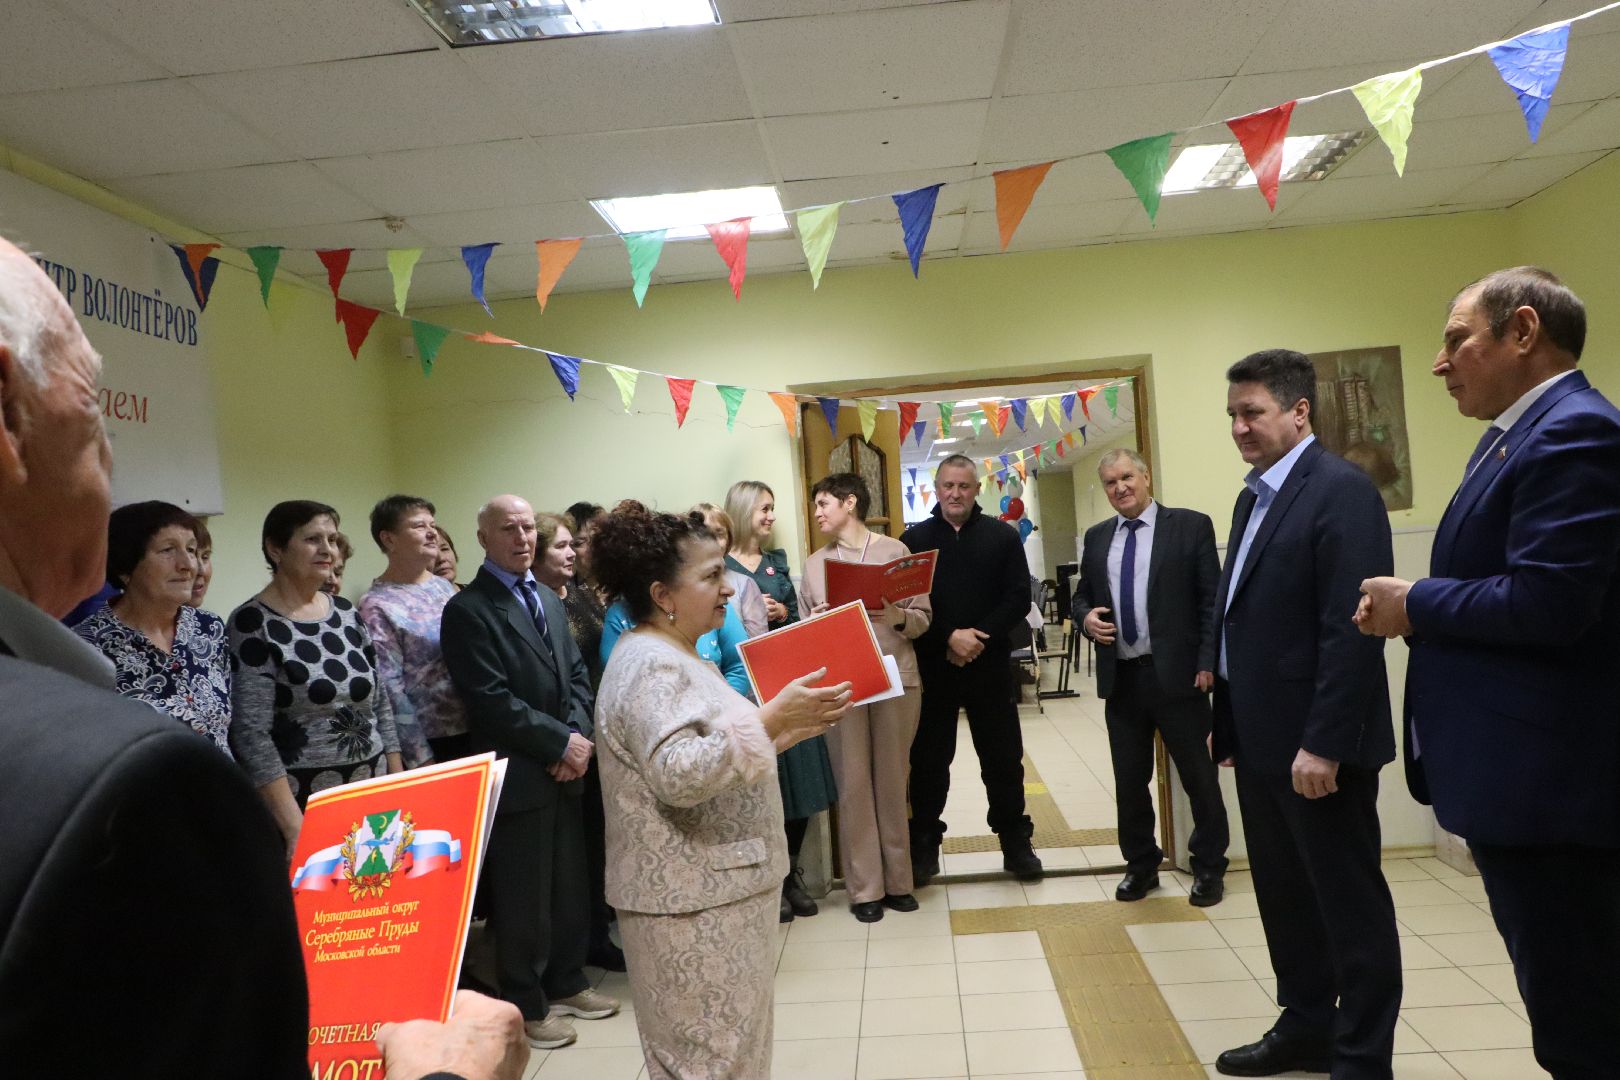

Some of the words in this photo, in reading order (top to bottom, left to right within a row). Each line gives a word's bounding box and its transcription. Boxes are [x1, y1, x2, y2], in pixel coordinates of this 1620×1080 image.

[83, 272, 197, 346] ВОЛОНТЁРОВ
[97, 387, 147, 423] аем
[313, 903, 389, 927] Муниципальный
[392, 901, 420, 916] округ
[305, 926, 376, 949] Серебряные
[379, 919, 420, 941] Пруды
[314, 947, 365, 963] Московской
[367, 943, 401, 957] области
[308, 1022, 381, 1045] ОЧЕТНАЯ
[311, 1058, 383, 1080] МОТ
